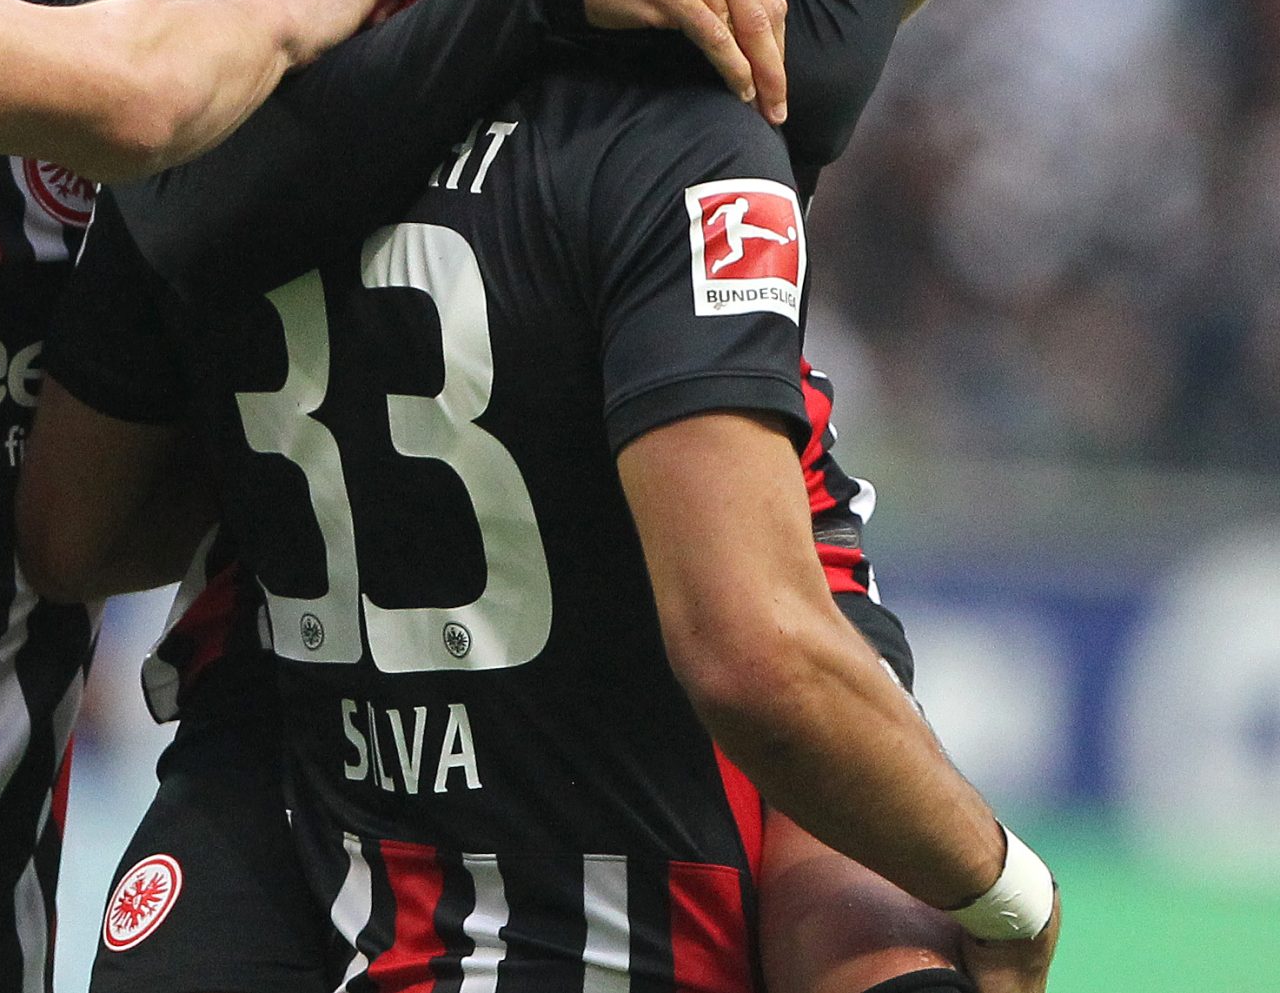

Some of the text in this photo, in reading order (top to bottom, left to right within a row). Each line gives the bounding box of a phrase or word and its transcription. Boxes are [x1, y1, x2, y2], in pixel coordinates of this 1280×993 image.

[706, 288, 797, 310] BUNDESLIGA
[234, 222, 553, 673] 33
[340, 697, 484, 795] SILVA
